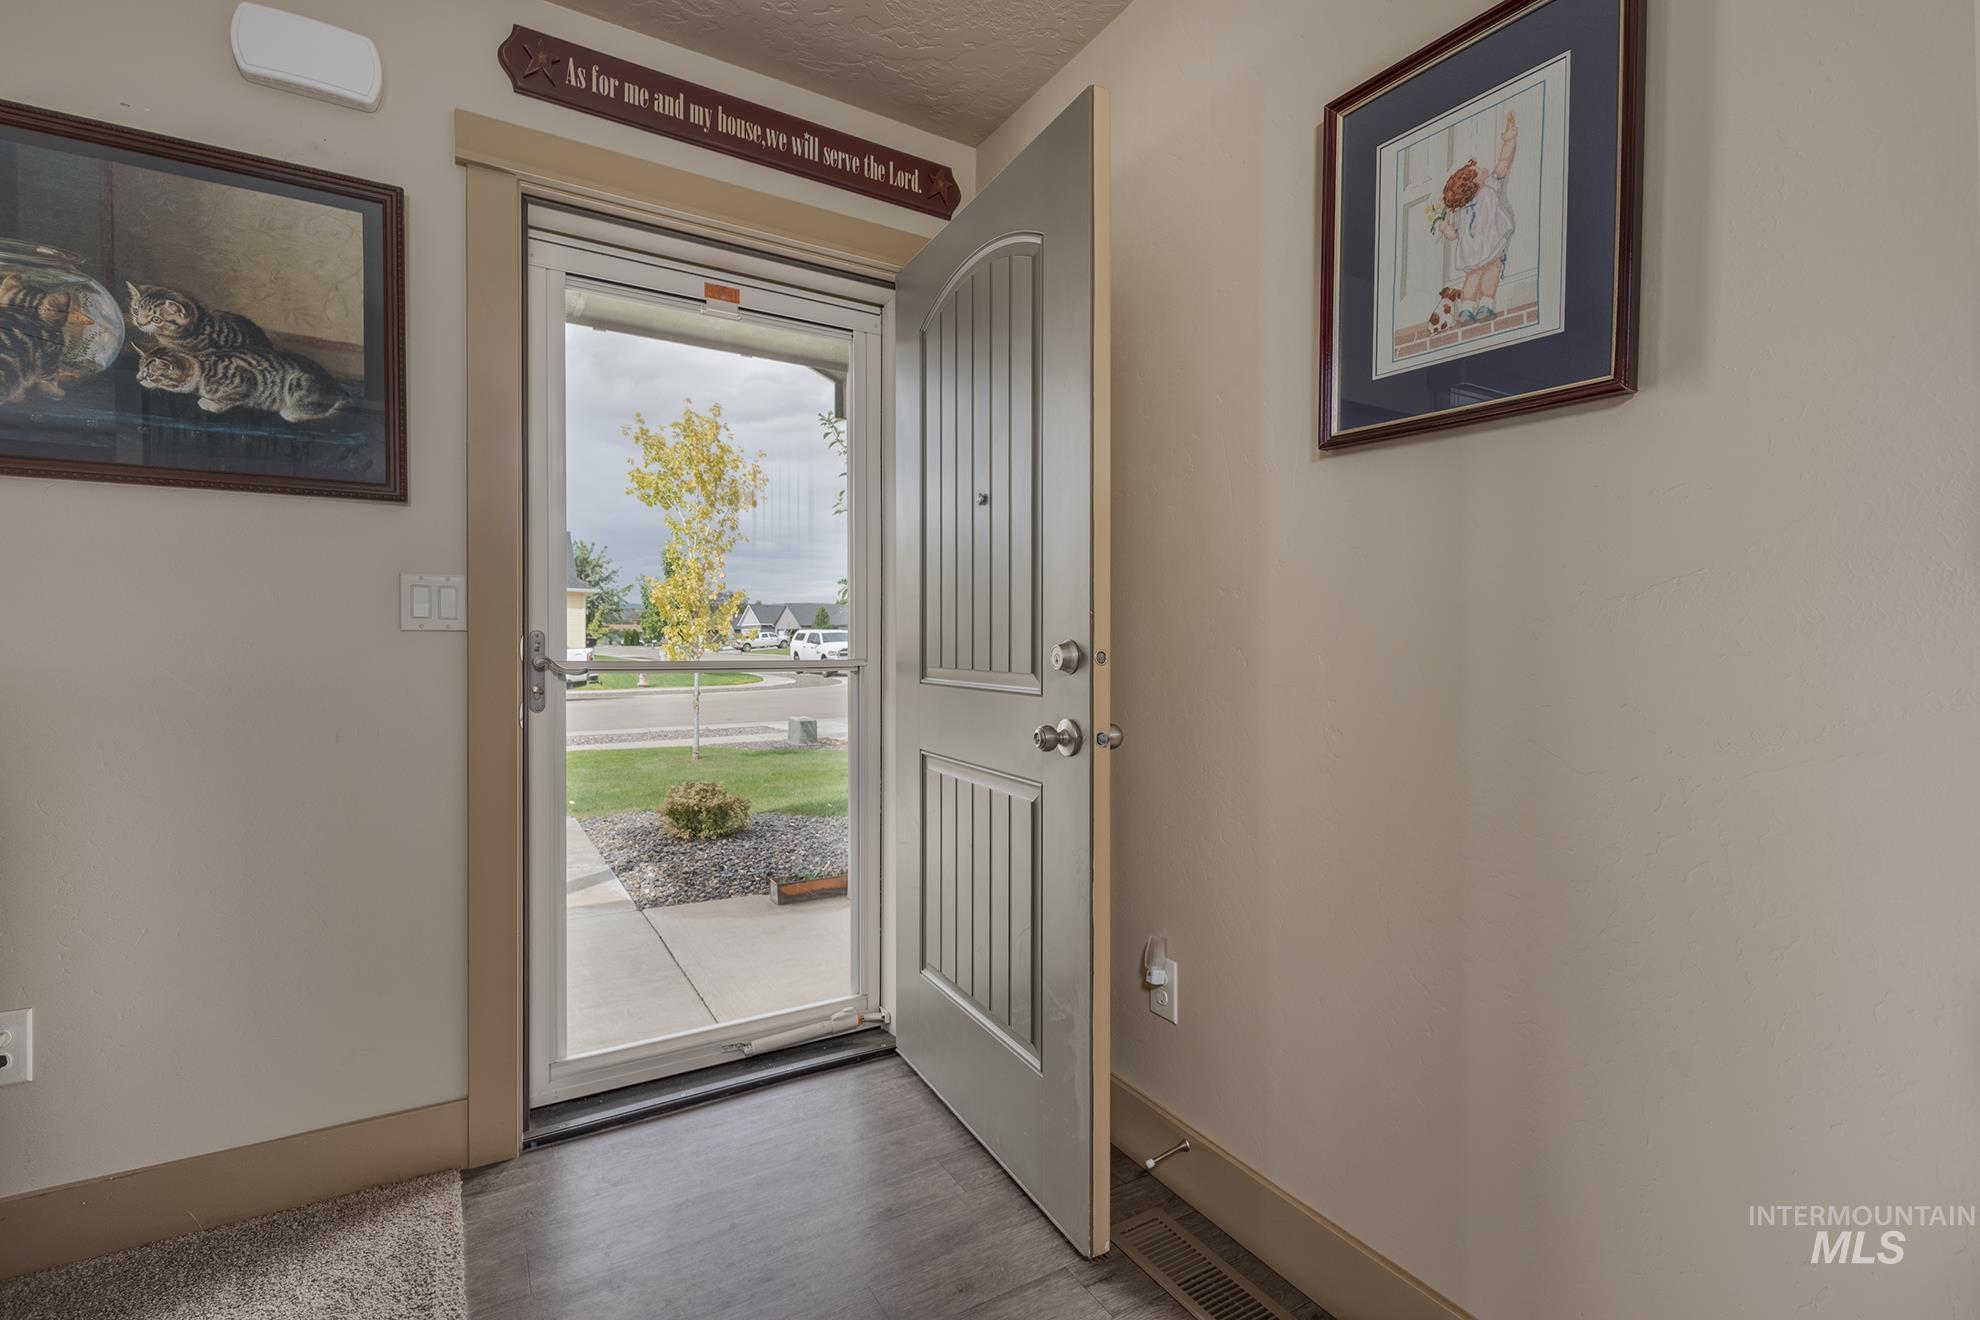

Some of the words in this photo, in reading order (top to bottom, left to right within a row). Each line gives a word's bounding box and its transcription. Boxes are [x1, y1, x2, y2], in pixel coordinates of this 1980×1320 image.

[565, 57, 586, 89] As
[591, 64, 619, 98] for
[624, 82, 649, 108] me
[654, 92, 684, 120] and
[689, 103, 712, 133] my
[791, 132, 819, 162] will
[823, 146, 860, 174] serve
[864, 154, 886, 182] the
[889, 161, 922, 194] Lord.
